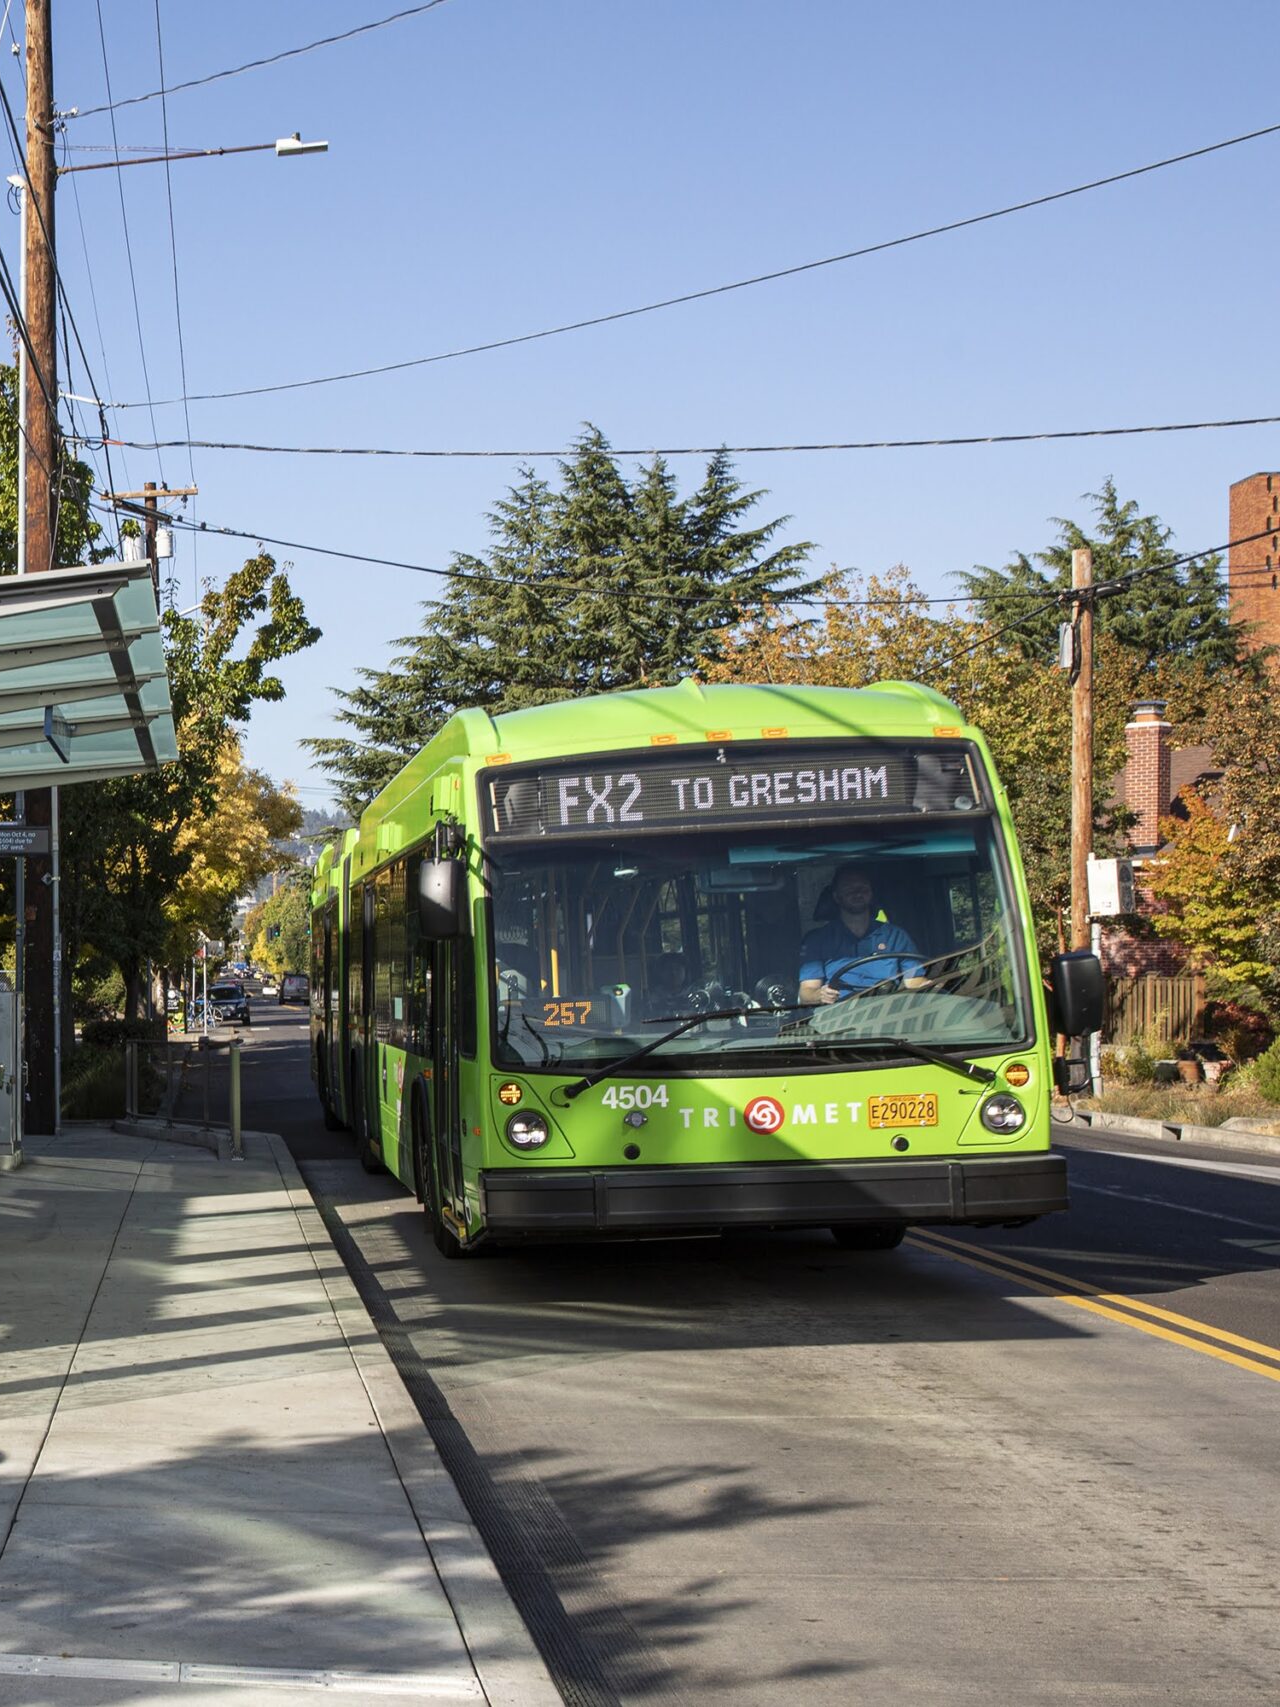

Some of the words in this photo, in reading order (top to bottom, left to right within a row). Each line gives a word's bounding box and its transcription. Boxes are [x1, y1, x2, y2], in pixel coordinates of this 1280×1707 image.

[558, 773, 644, 826] FX2
[671, 777, 713, 810] TO
[729, 766, 888, 808] GRESHAM
[543, 1001, 592, 1027] 257
[601, 1085, 669, 1109] 4504
[679, 1107, 736, 1128] TRI
[791, 1102, 863, 1125] MET
[871, 1101, 935, 1120] E290228
